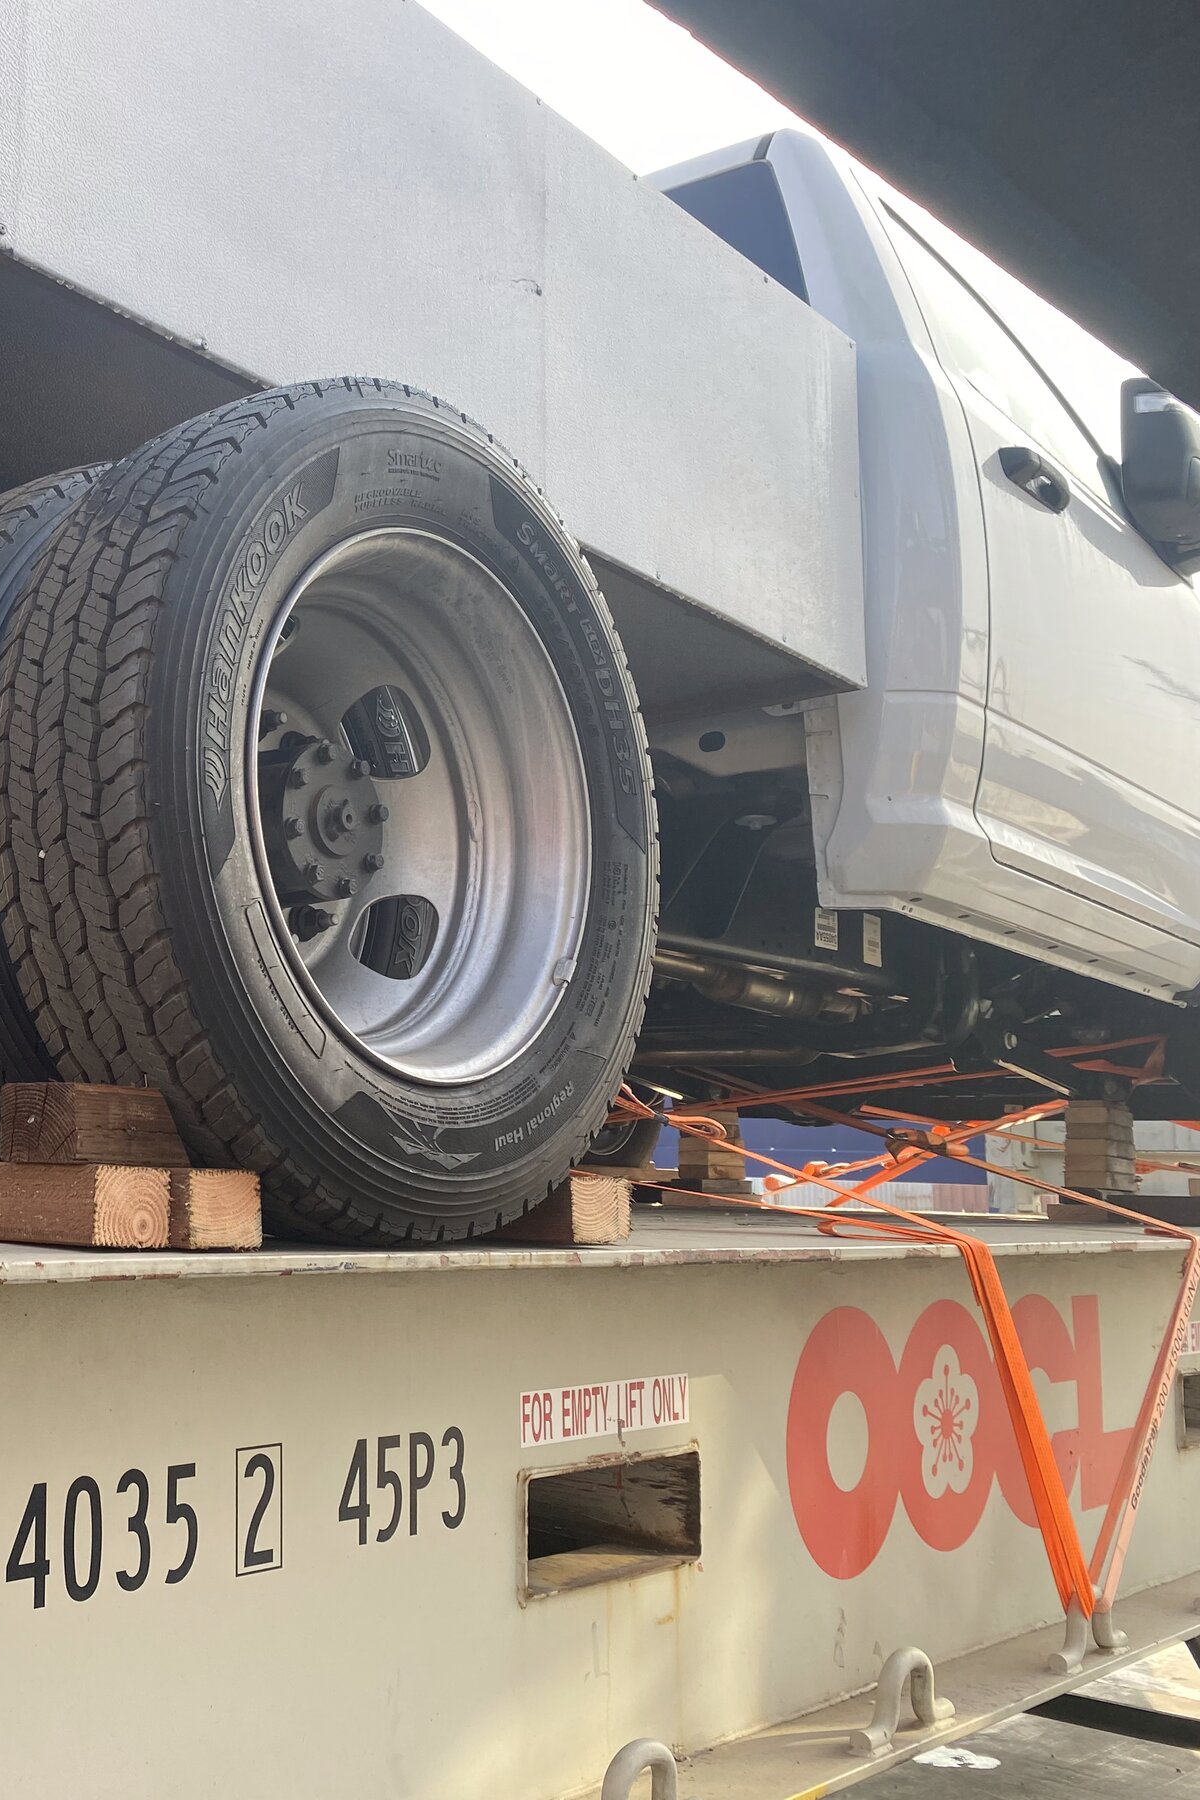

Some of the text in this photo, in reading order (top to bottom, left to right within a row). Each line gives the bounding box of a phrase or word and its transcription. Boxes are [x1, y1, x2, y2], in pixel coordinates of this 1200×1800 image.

[494, 1127, 524, 1152] Haul
[526, 1080, 575, 1136] Regional
[521, 1375, 687, 1444] FOR EMPTY LIFT ONLY
[785, 1293, 1138, 1581] OOCL
[1130, 1417, 1160, 1511] Goodstrap
[1155, 1381, 1170, 1419] 200
[243, 1453, 275, 1568] 2
[337, 1425, 467, 1546] 45P3
